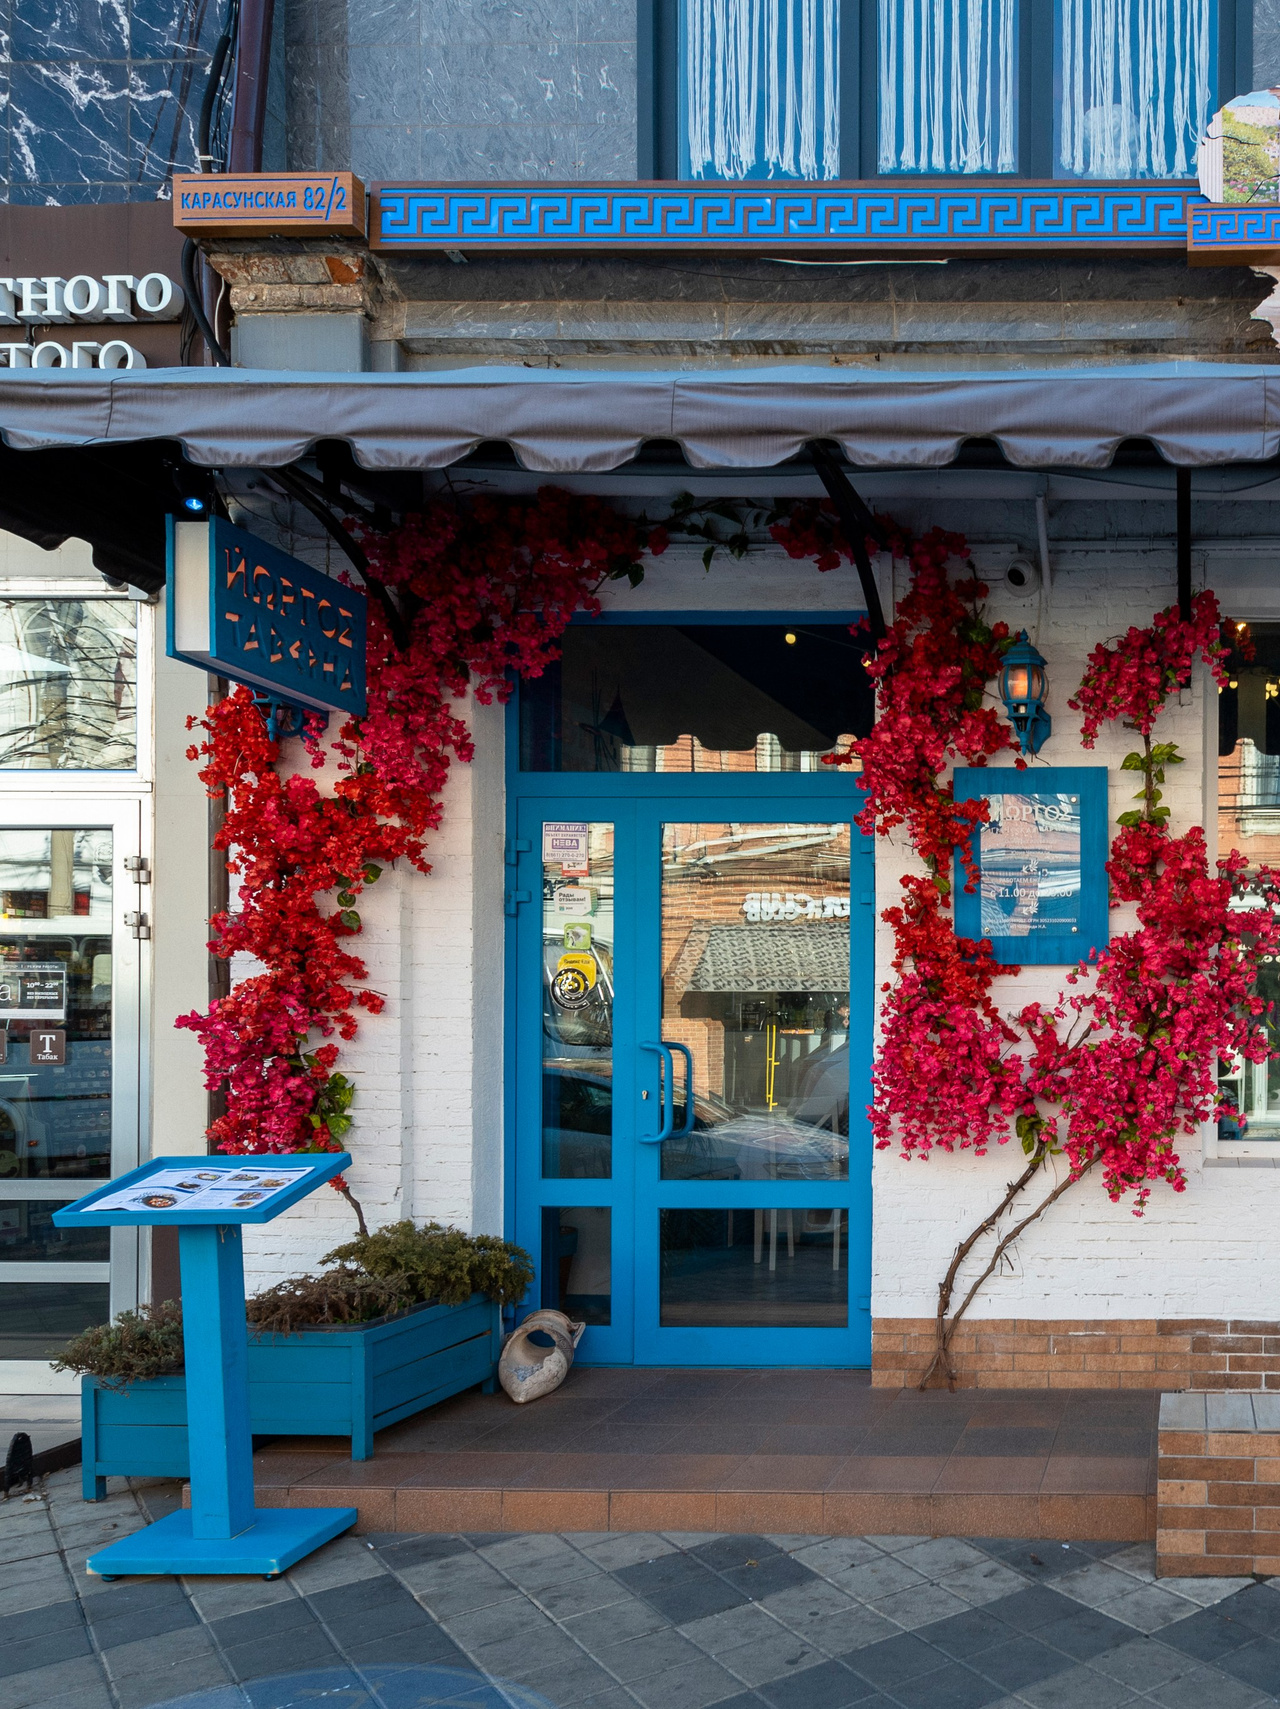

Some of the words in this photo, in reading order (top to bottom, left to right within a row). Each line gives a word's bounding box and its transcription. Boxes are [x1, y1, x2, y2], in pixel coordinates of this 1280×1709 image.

[181, 191, 297, 210] КАРАСУНСКАЯ
[303, 176, 347, 221] 82/2
[224, 611, 361, 699] ТАВЕРНА
[553, 839, 578, 847] НЕВА
[998, 888, 1026, 898] 11.00
[39, 1034, 56, 1053] Т
[36, 1053, 59, 1061] Табак
